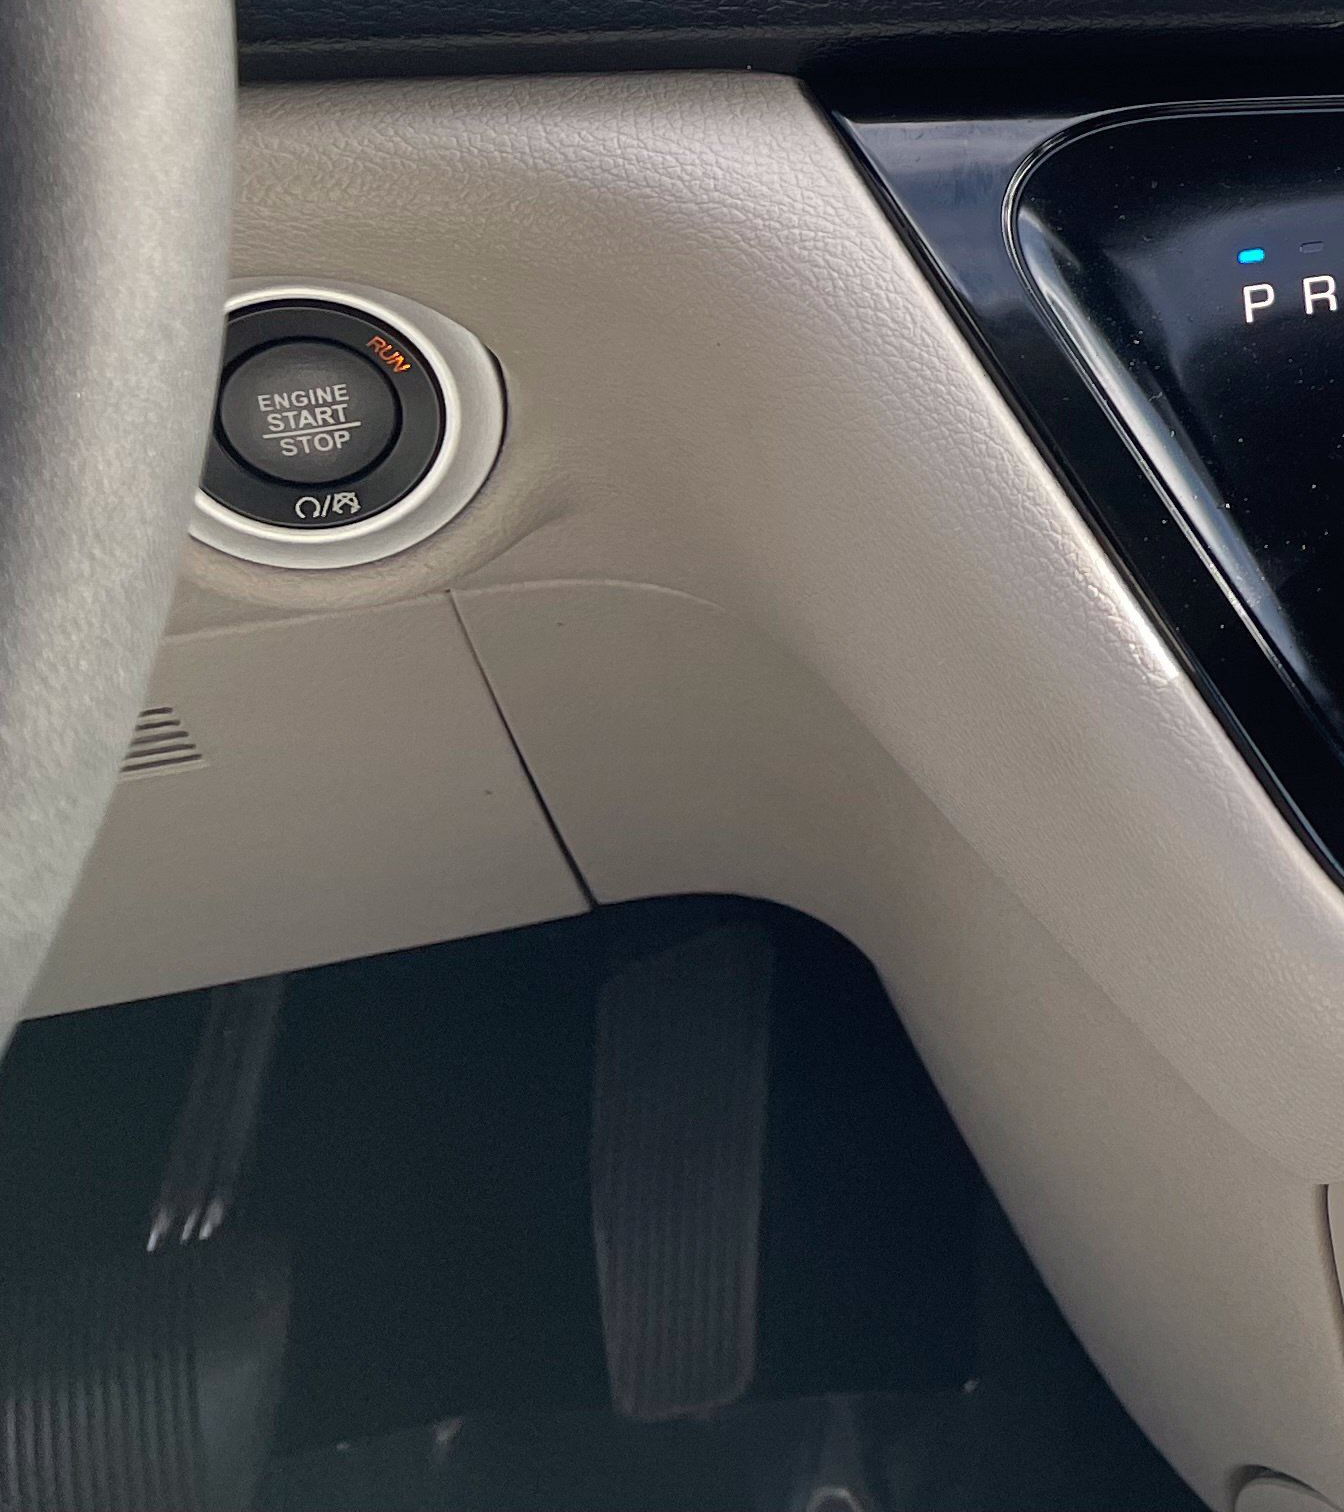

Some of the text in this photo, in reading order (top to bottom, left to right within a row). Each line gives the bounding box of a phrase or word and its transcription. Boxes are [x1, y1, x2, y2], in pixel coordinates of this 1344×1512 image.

[1243, 283, 1275, 323] P
[1302, 275, 1338, 315] R
[366, 335, 411, 373] RUN
[256, 383, 350, 412] ENGINE
[267, 403, 348, 432] START
[279, 430, 350, 457] STOP
